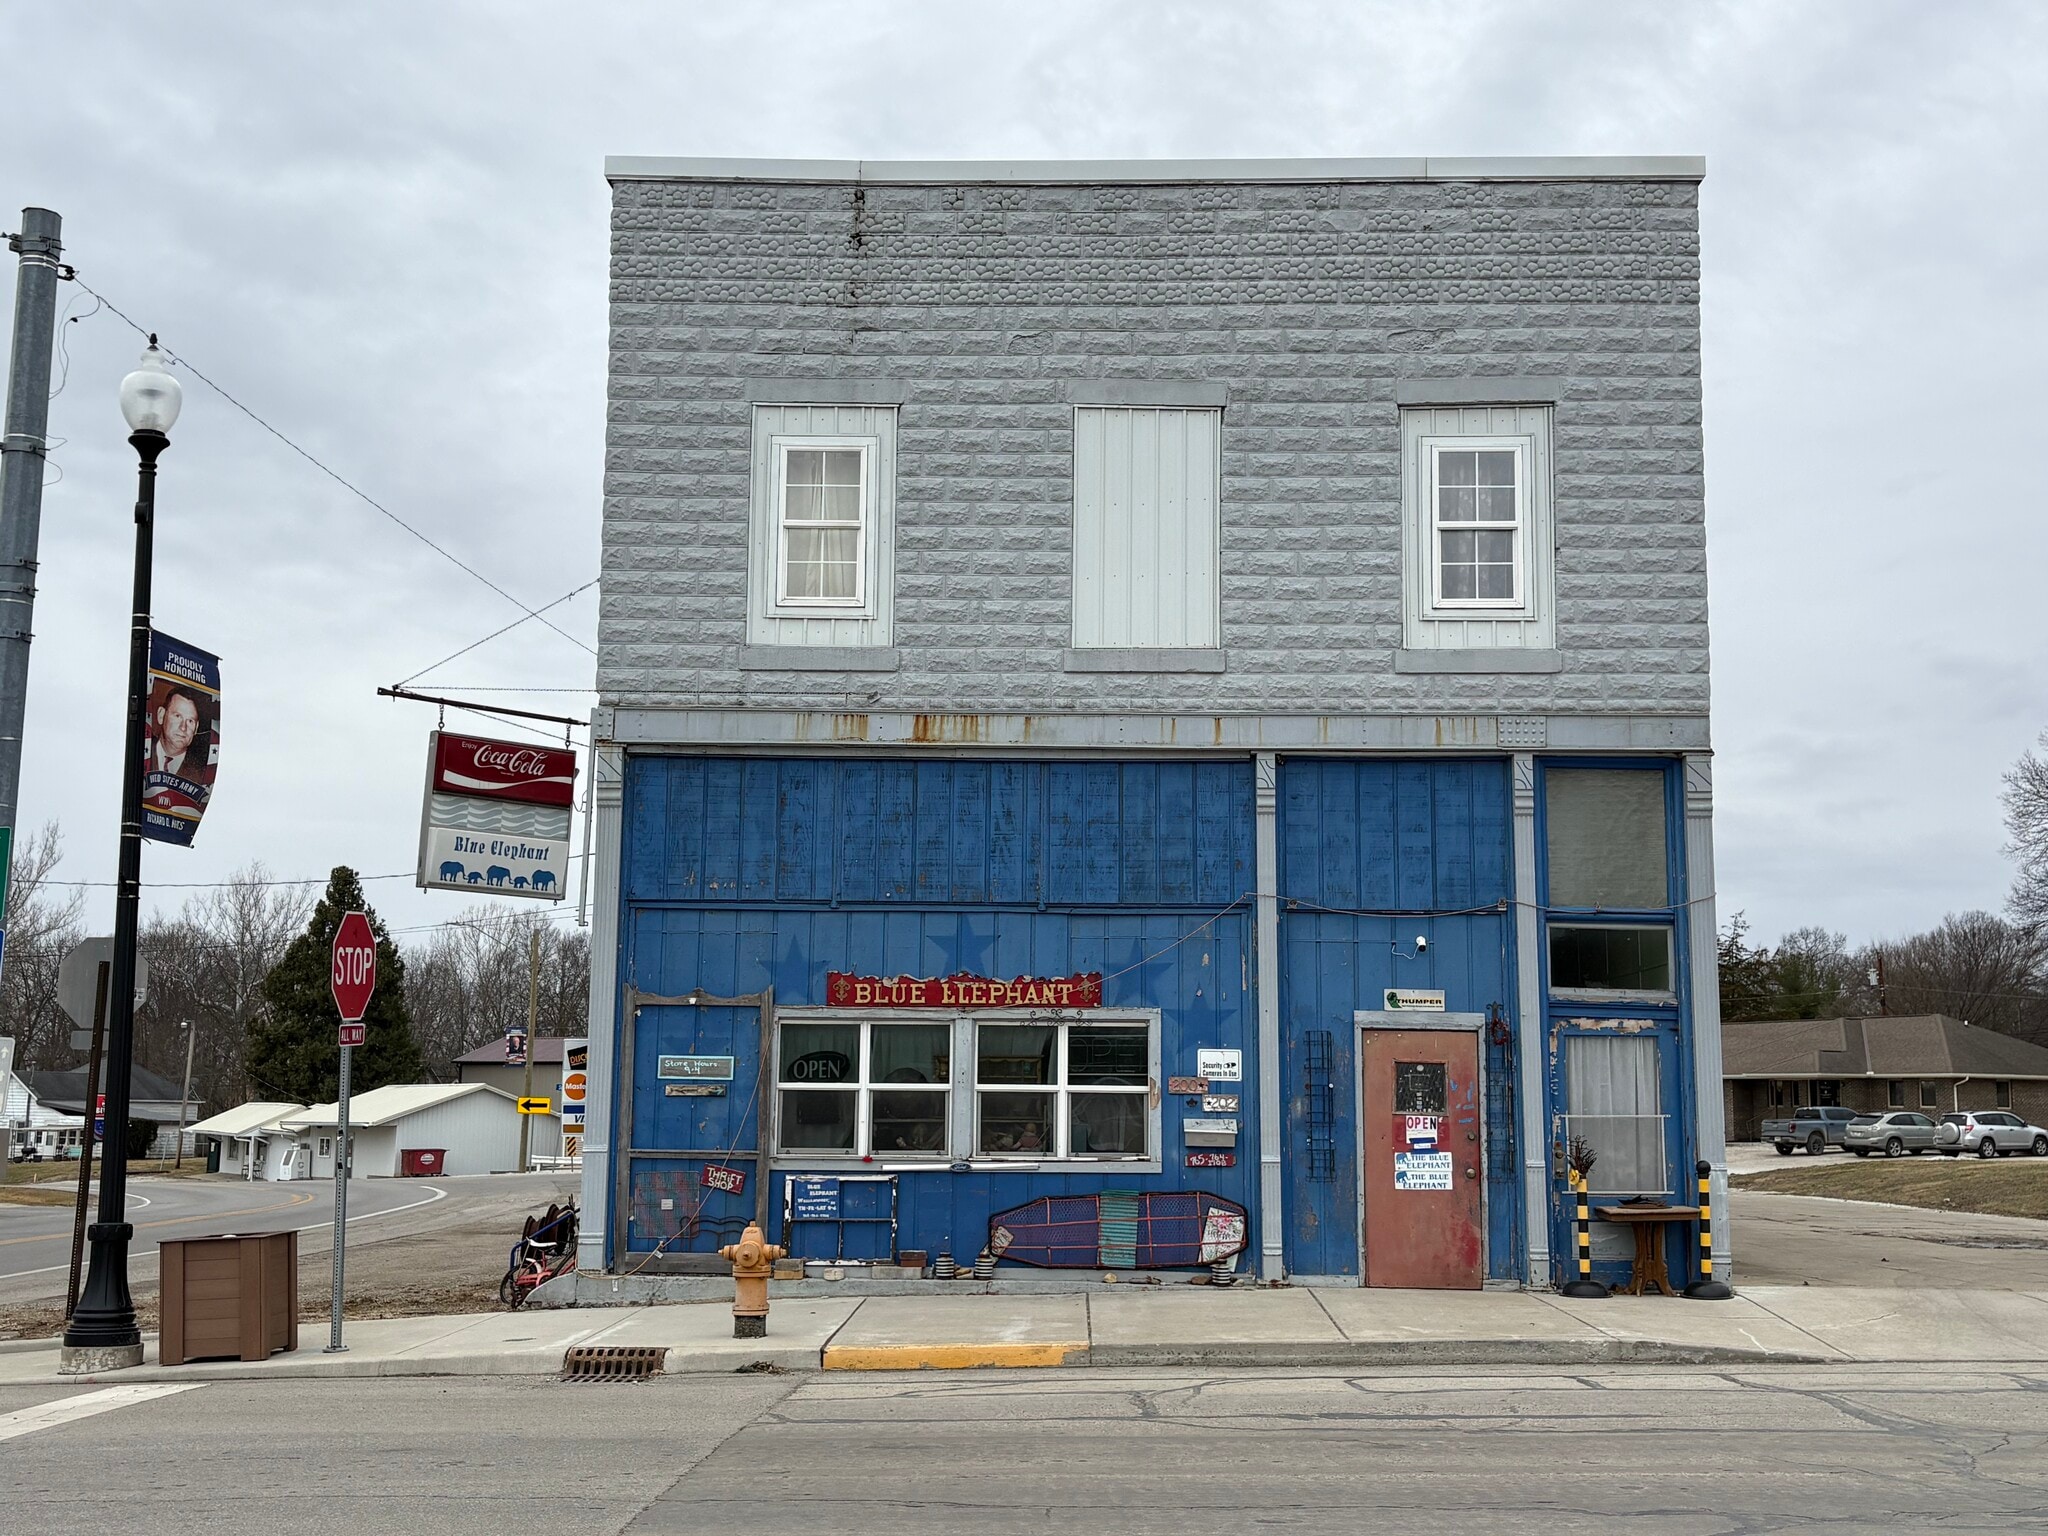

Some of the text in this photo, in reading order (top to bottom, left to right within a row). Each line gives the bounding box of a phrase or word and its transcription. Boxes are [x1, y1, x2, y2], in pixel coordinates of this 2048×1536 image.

[168, 652, 203, 673] PROUDLY
[164, 661, 206, 684] HONORING
[461, 741, 478, 750] Enjoy
[473, 744, 548, 776] Coca-Cola
[178, 781, 199, 796] ARMY
[454, 836, 550, 861] Blue Elephant
[335, 946, 373, 986] STOP
[854, 983, 1073, 1005] BLUE ELEPHANT
[341, 1028, 363, 1041] ALL WAY
[793, 1059, 840, 1079] OPEN
[1202, 1061, 1222, 1070] Security
[1228, 1069, 1237, 1077] Use
[1171, 1079, 1198, 1092] 200
[1211, 1096, 1236, 1110] 202
[1406, 1116, 1437, 1130] OPEN
[708, 1177, 734, 1191] SHOP
